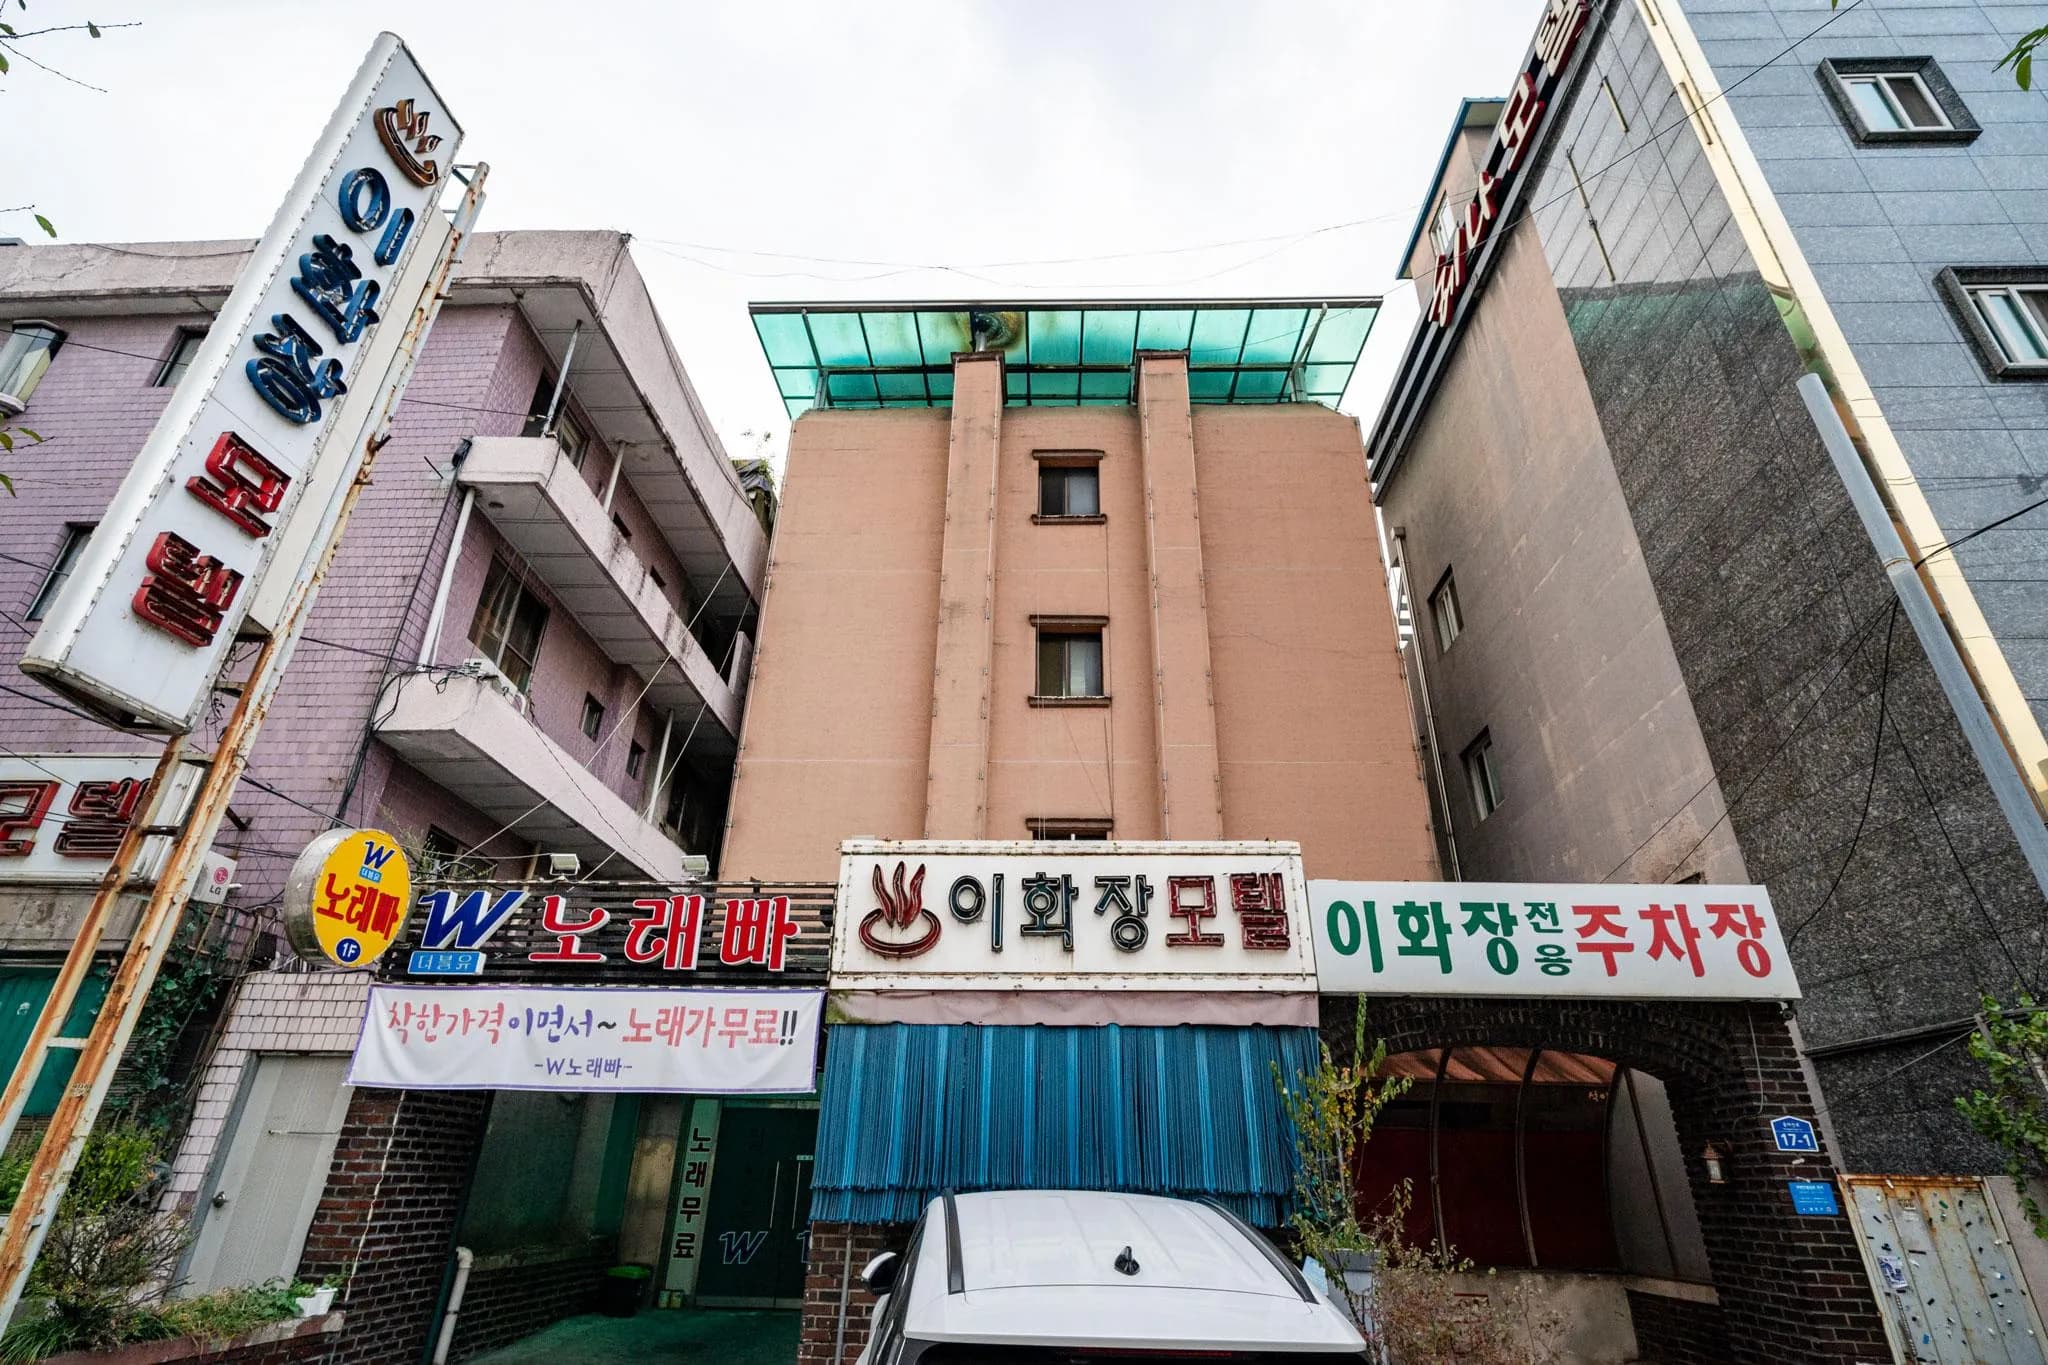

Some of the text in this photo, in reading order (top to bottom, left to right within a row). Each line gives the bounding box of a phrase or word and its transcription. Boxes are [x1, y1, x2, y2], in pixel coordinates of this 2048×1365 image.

[364, 840, 395, 870] W
[360, 867, 381, 882] 더블유
[209, 885, 222, 896] LG
[316, 873, 401, 941] 노래빠
[417, 890, 802, 972] W 노래빠
[341, 941, 358, 959] 1F
[417, 953, 473, 971] 더블유
[1780, 1132, 1812, 1147] 17-1
[718, 1230, 769, 1265] W
